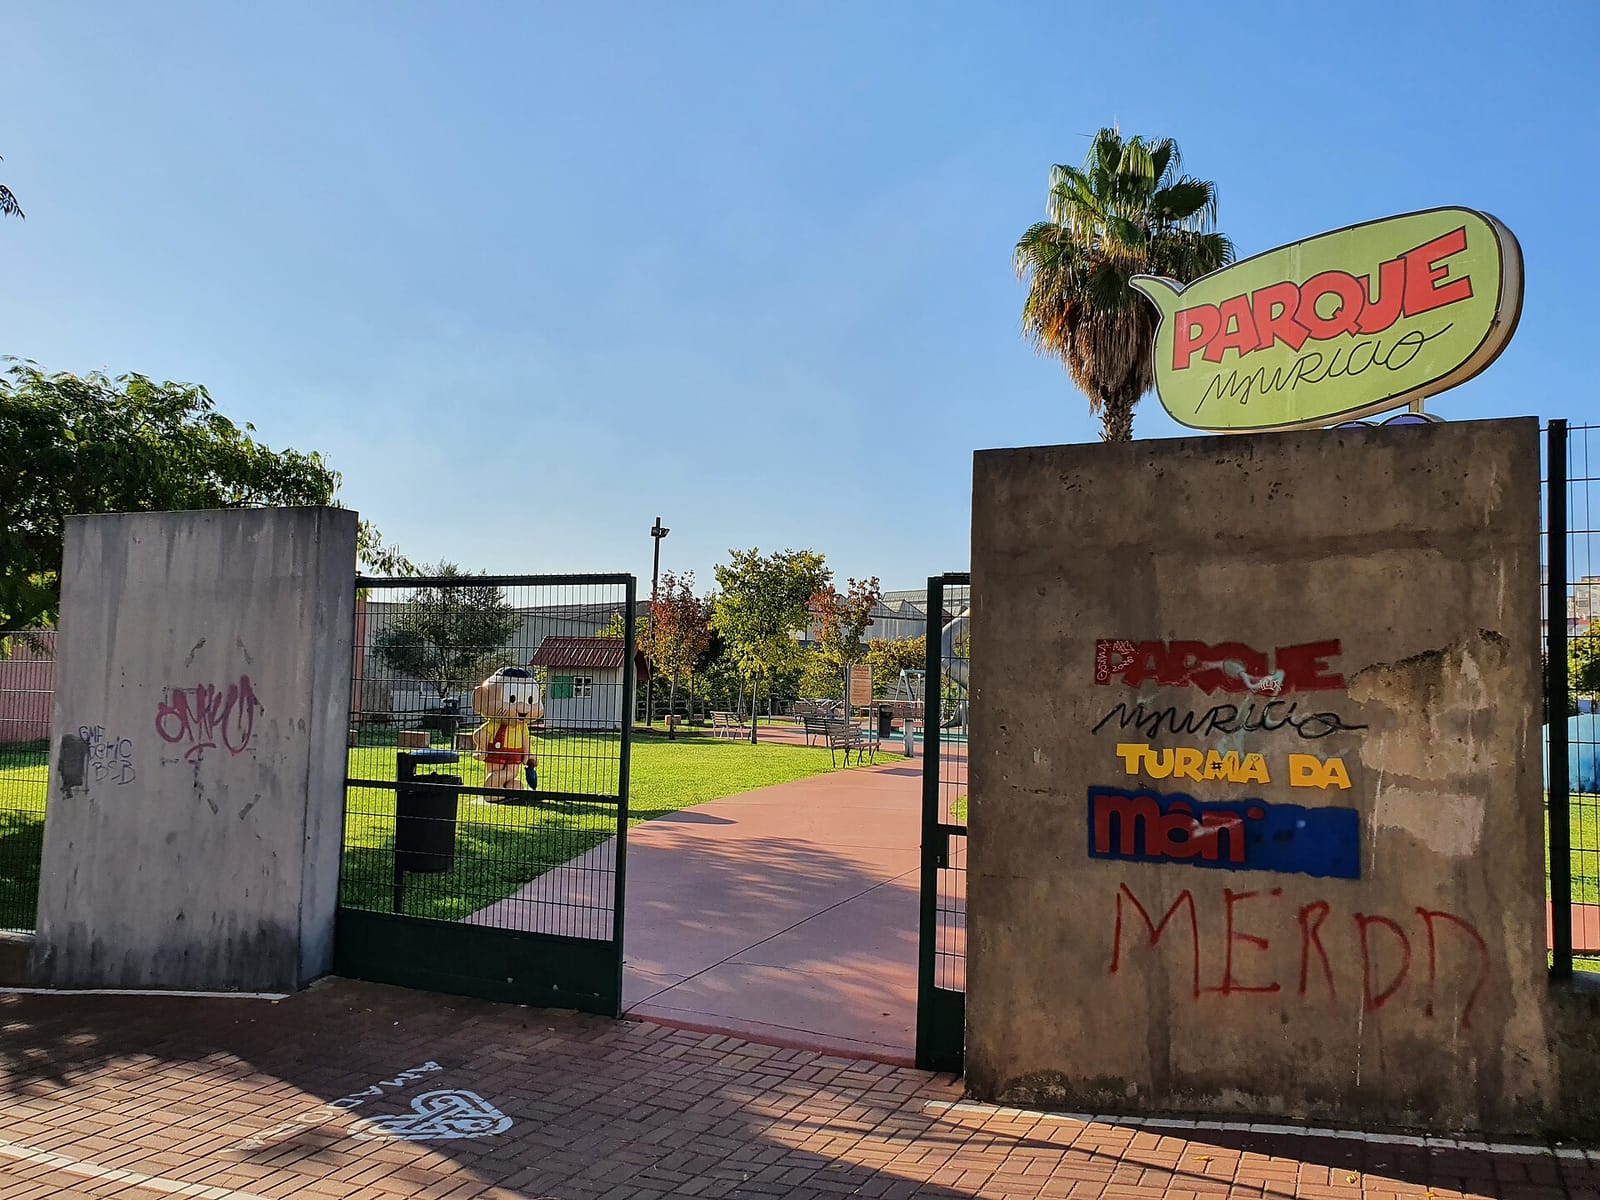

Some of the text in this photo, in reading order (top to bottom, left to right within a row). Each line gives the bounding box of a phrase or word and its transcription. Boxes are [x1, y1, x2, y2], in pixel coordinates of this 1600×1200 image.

[1172, 225, 1474, 371] PARQUE
[1094, 638, 1346, 697] PARQUE
[1116, 743, 1353, 790] TURMA DA
